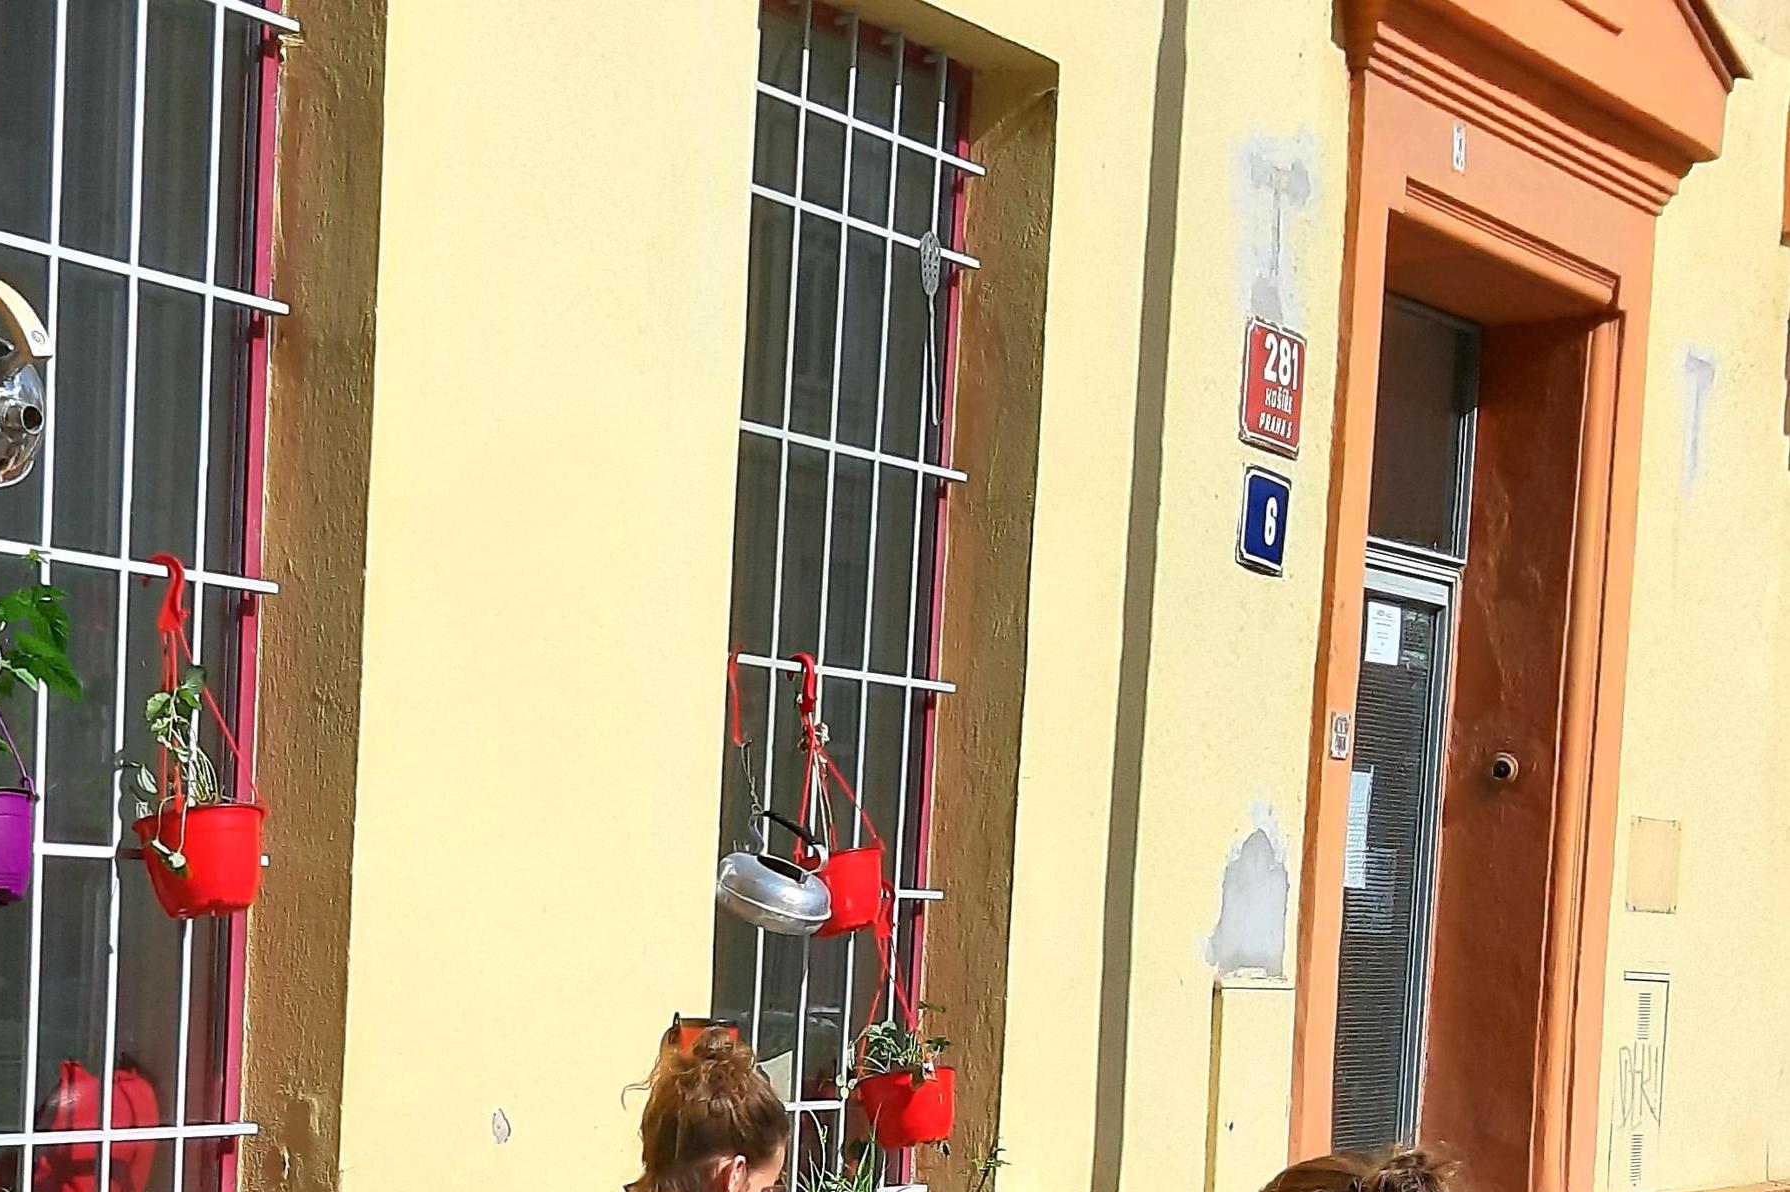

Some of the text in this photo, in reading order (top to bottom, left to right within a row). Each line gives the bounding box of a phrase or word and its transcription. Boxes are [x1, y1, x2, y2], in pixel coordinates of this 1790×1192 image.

[1263, 332, 1299, 391] 281
[1258, 412, 1286, 437] PRAHA
[1263, 496, 1278, 547] 6
